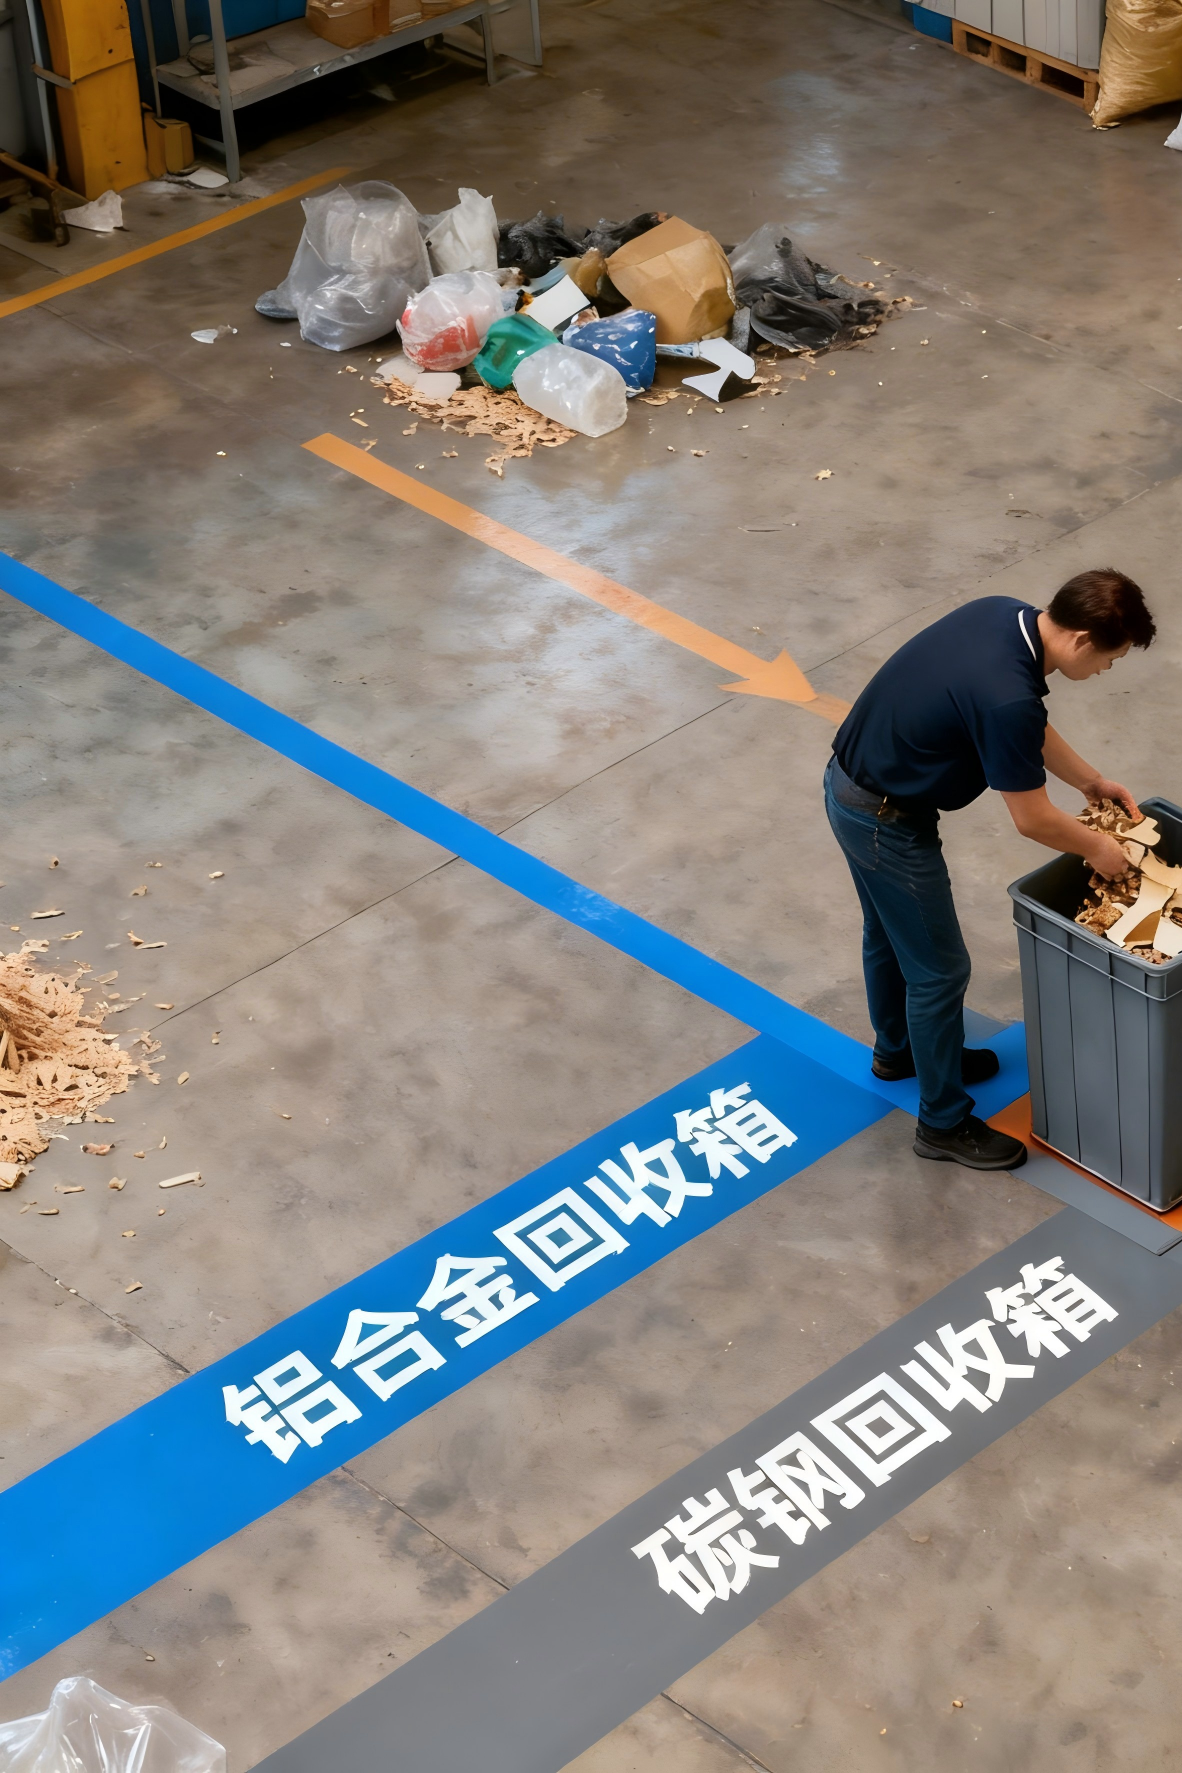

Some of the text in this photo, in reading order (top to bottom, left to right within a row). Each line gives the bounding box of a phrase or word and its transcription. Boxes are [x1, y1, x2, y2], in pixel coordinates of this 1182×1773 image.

[222, 1081, 798, 1463] 铝合金回收箱
[631, 1256, 1118, 1615] 碳钢回收箱
